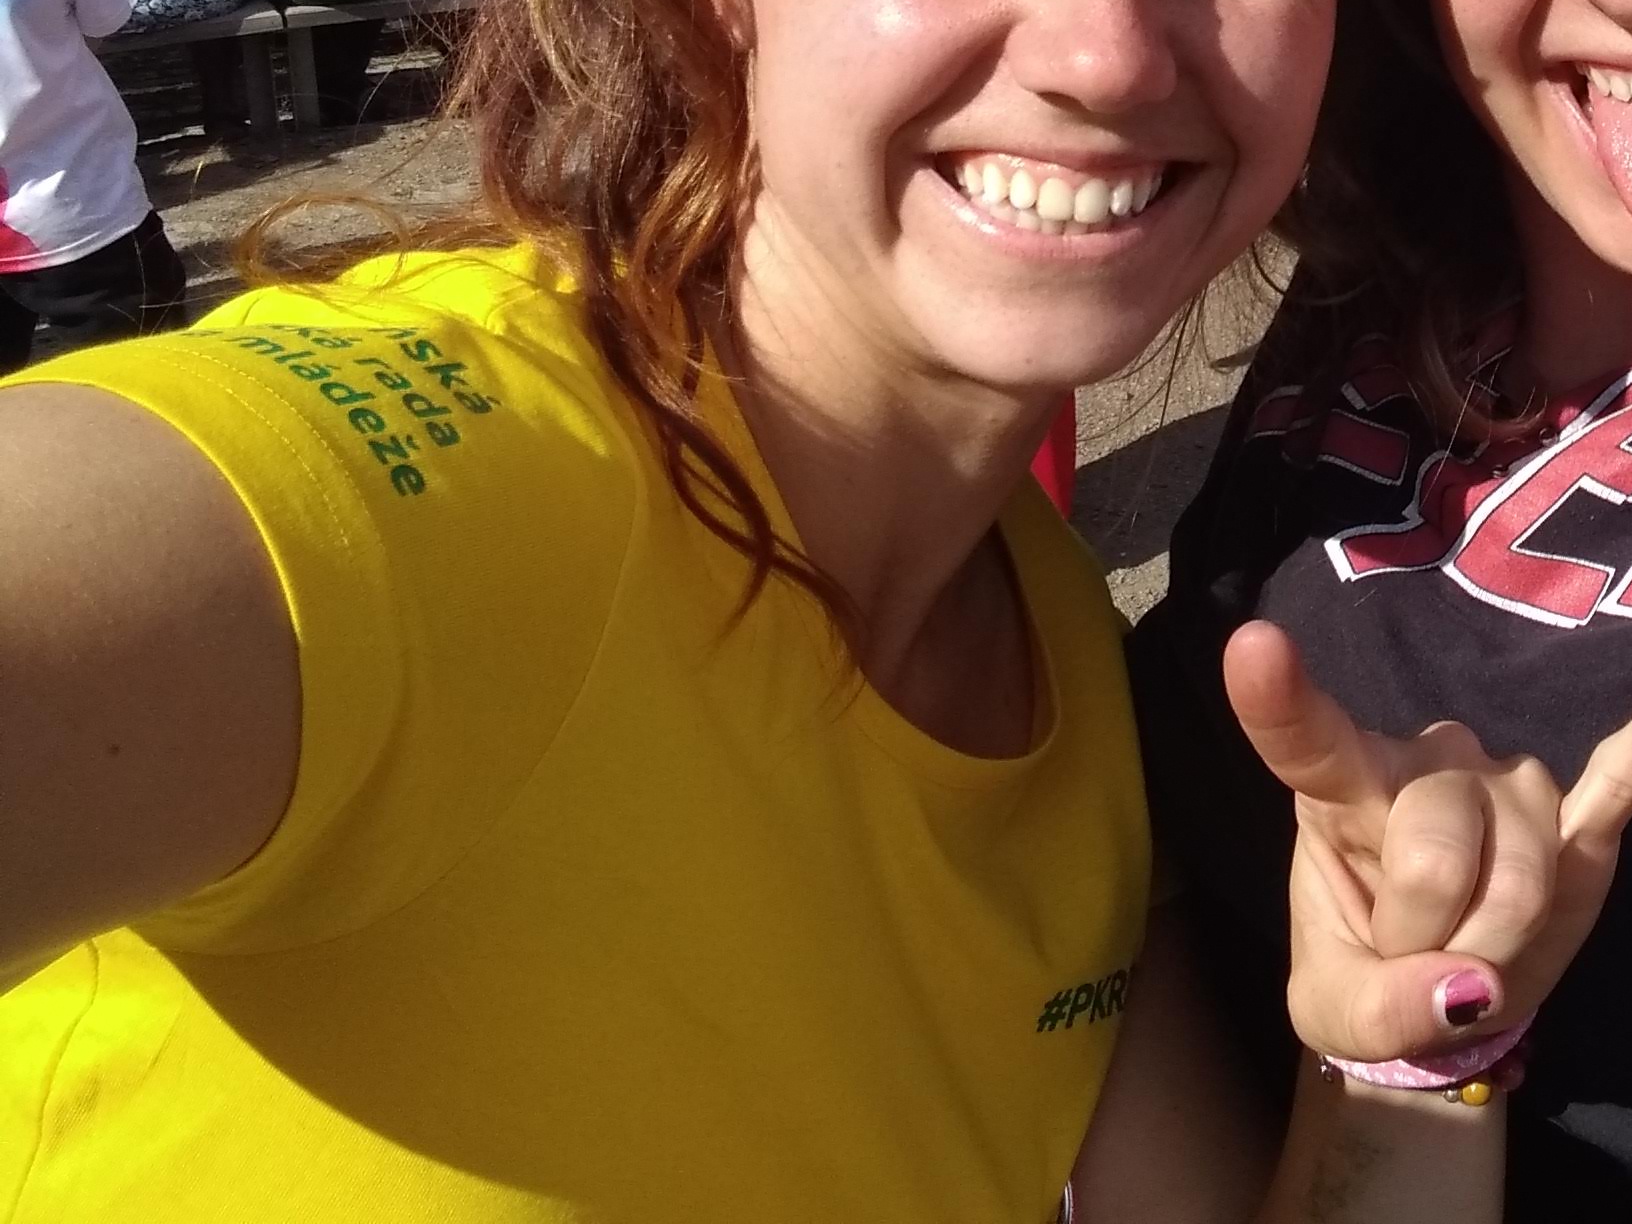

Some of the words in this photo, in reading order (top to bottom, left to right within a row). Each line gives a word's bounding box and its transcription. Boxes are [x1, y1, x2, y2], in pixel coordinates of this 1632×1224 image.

[223, 336, 428, 497] mládeže
[352, 357, 461, 447] rada
[1036, 965, 1134, 1032] #PKR
